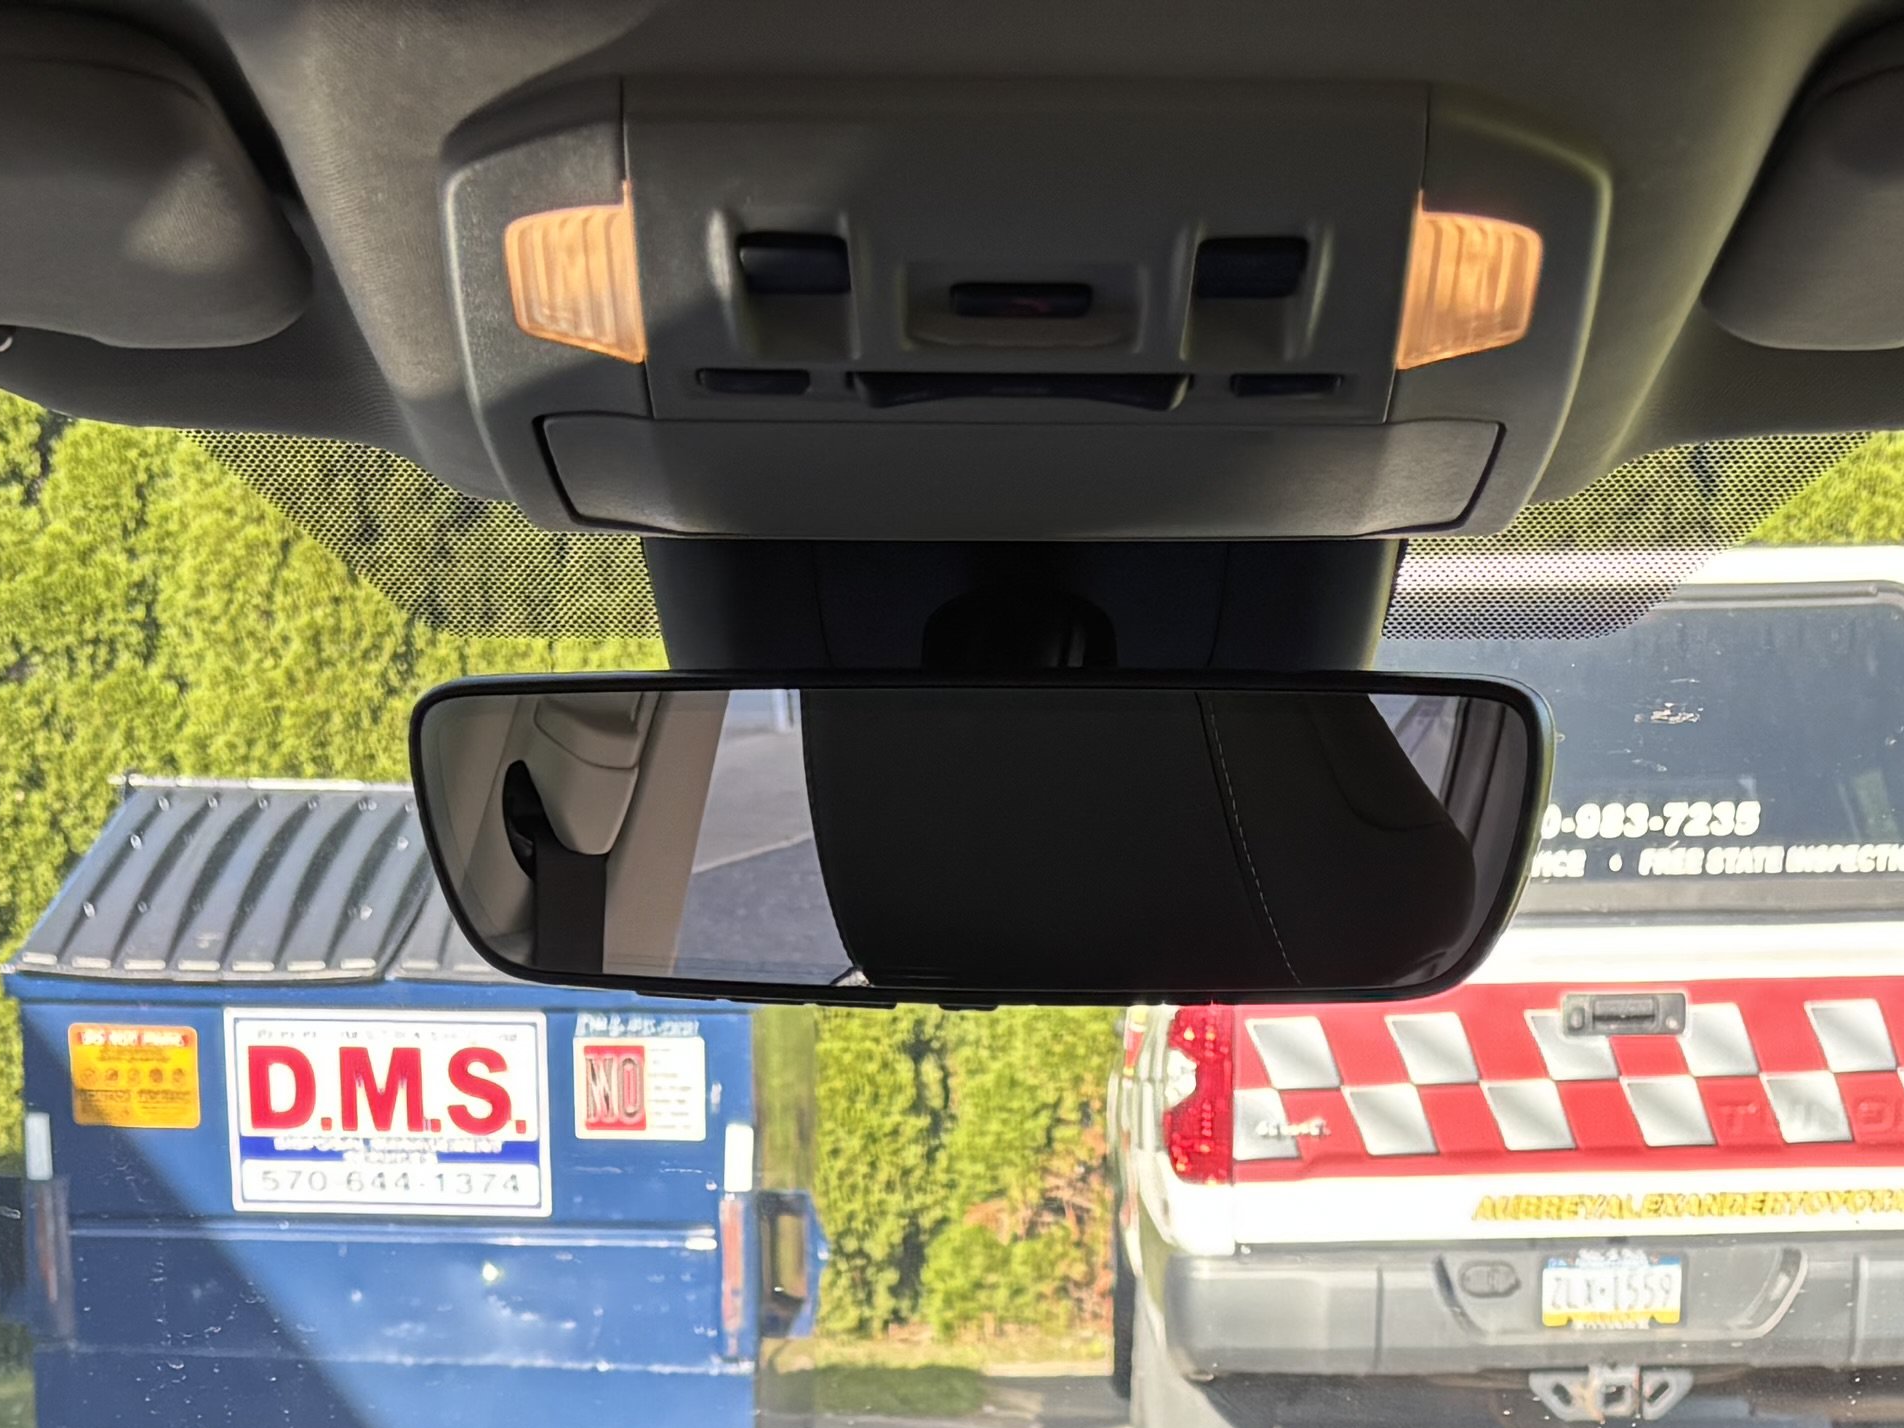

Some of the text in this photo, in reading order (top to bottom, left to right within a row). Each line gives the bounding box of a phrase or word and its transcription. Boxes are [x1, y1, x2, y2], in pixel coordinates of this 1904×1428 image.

[1705, 845, 1785, 875] STATE
[248, 1045, 527, 1136] D.M.S.
[584, 1053, 644, 1124] NO
